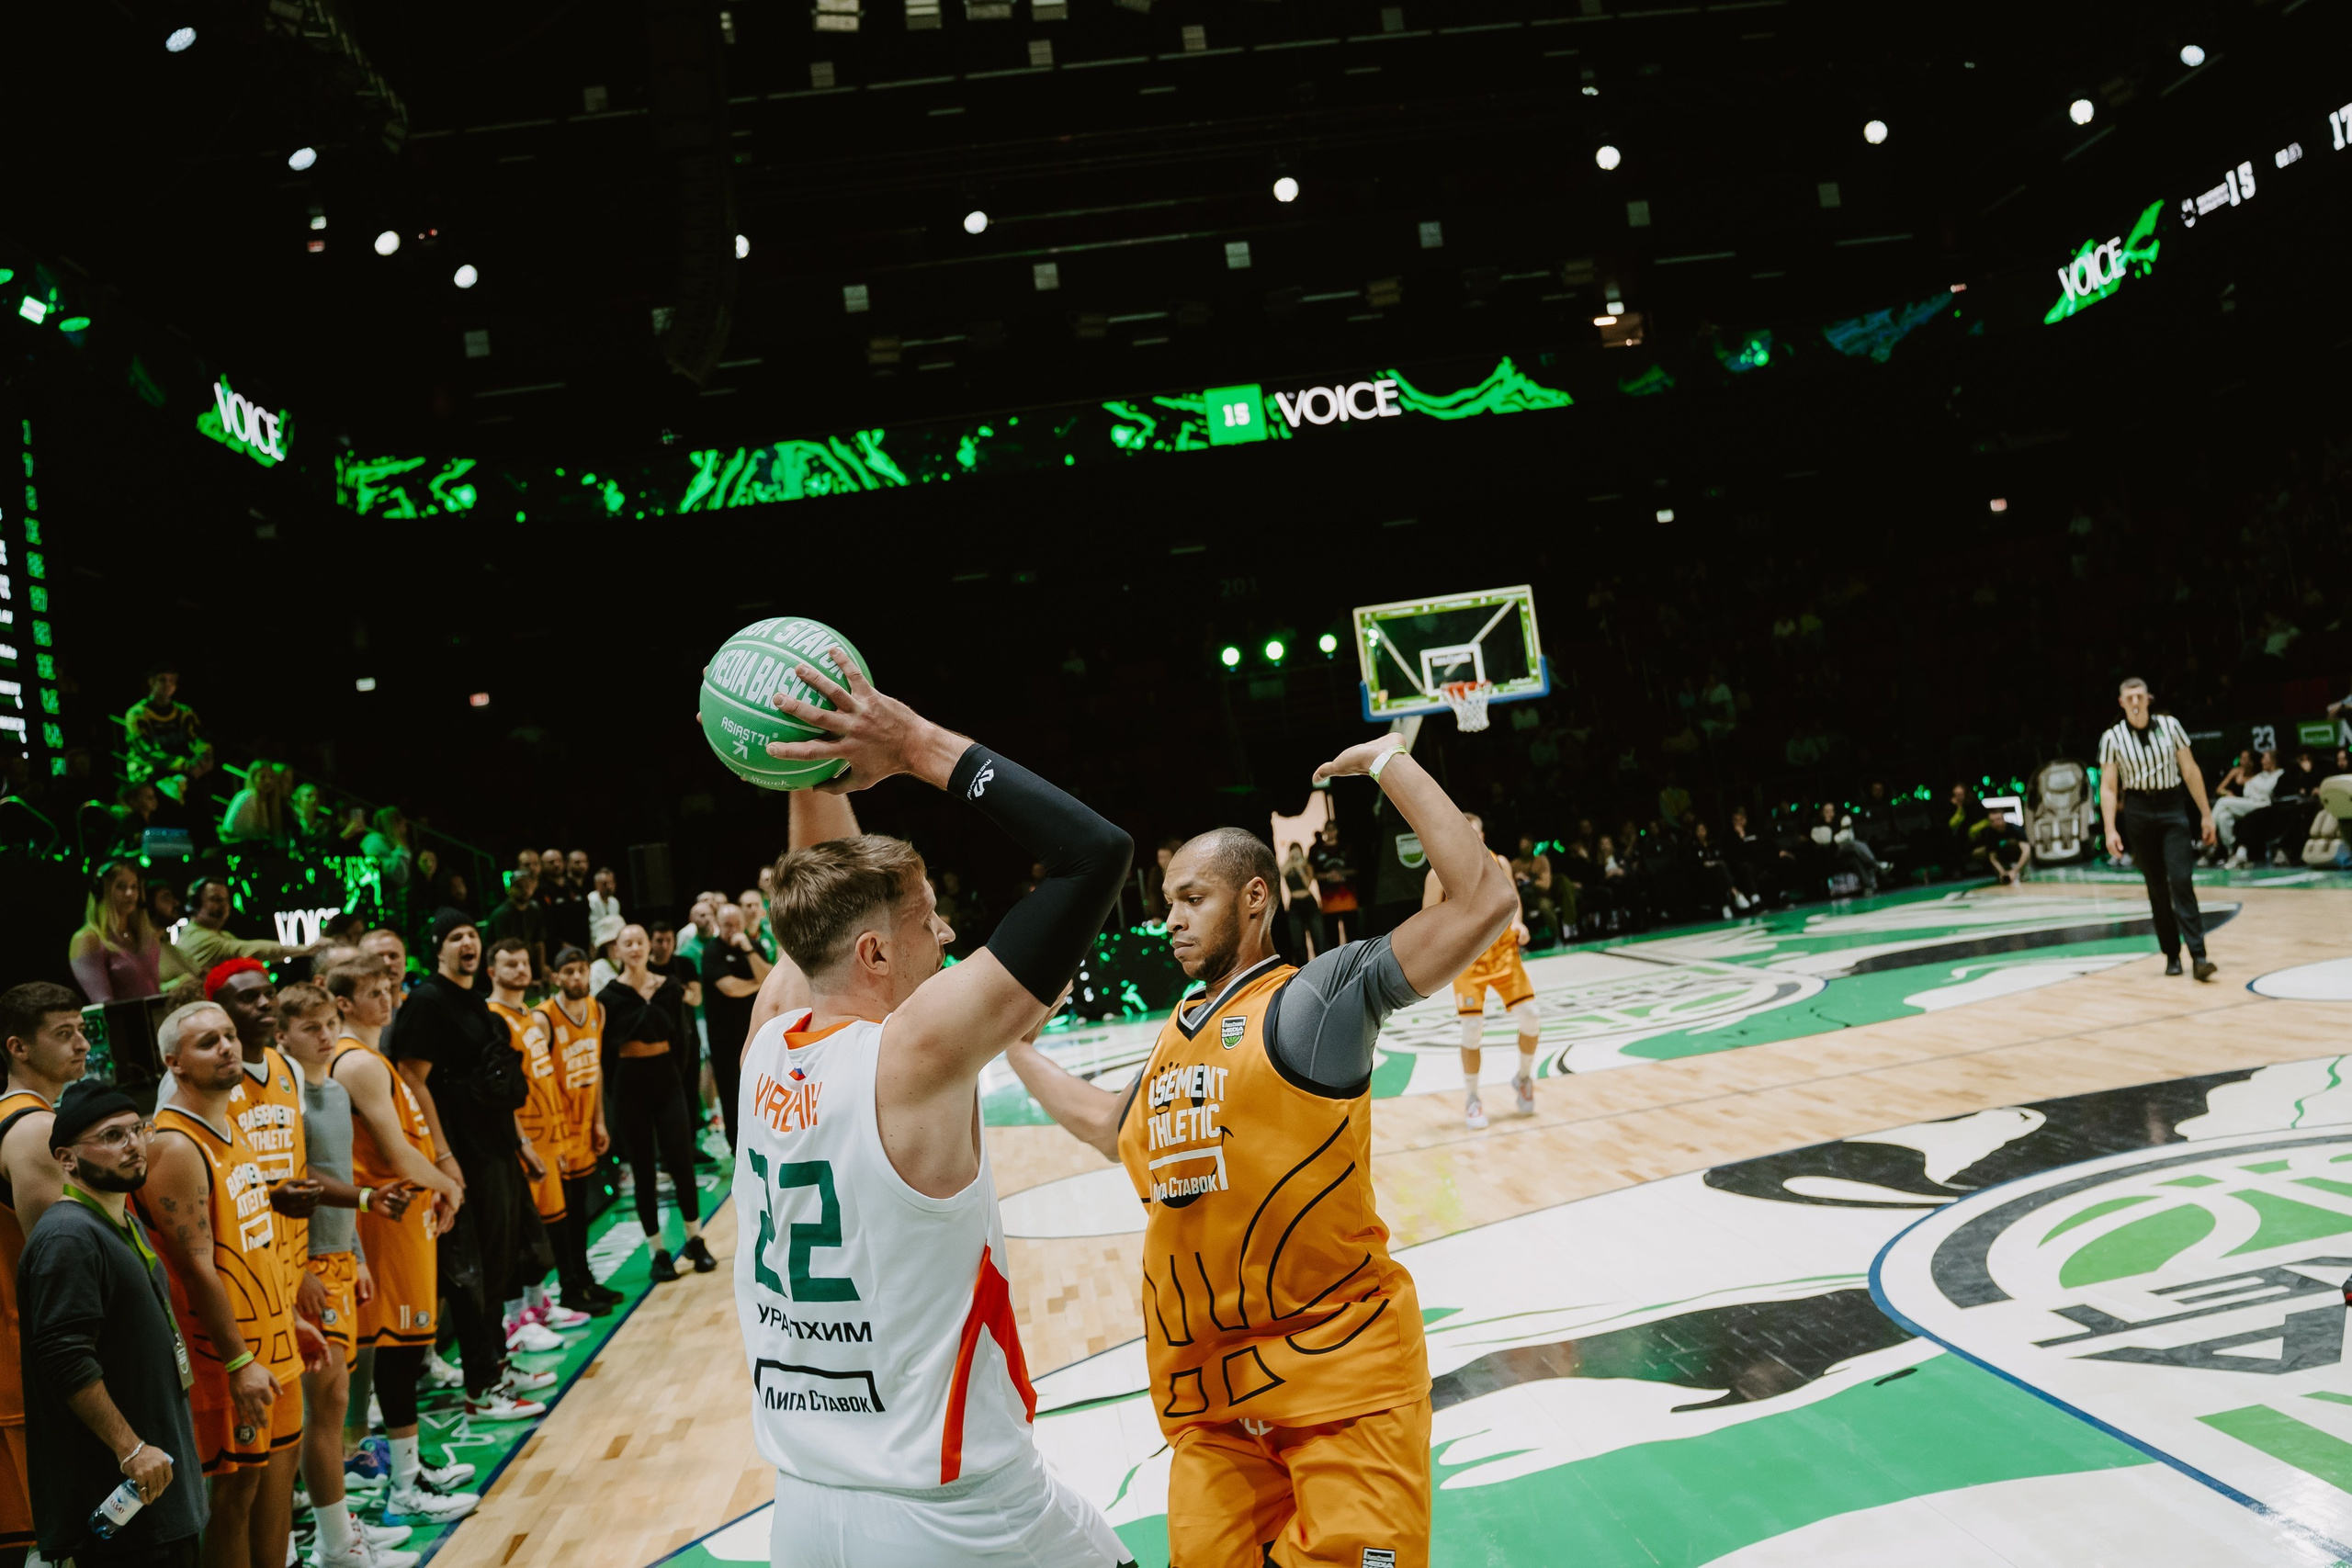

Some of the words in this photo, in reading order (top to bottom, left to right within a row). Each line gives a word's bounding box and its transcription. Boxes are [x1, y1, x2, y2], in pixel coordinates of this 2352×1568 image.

[2057, 236, 2127, 301] VOICE
[213, 381, 285, 462] VOICE
[1274, 378, 1403, 428] VOICE
[710, 649, 760, 697] MEDIA
[1148, 1065, 1229, 1110] ASEMENT
[1148, 1104, 1221, 1151] THLETIC
[748, 1147, 861, 1303] 22
